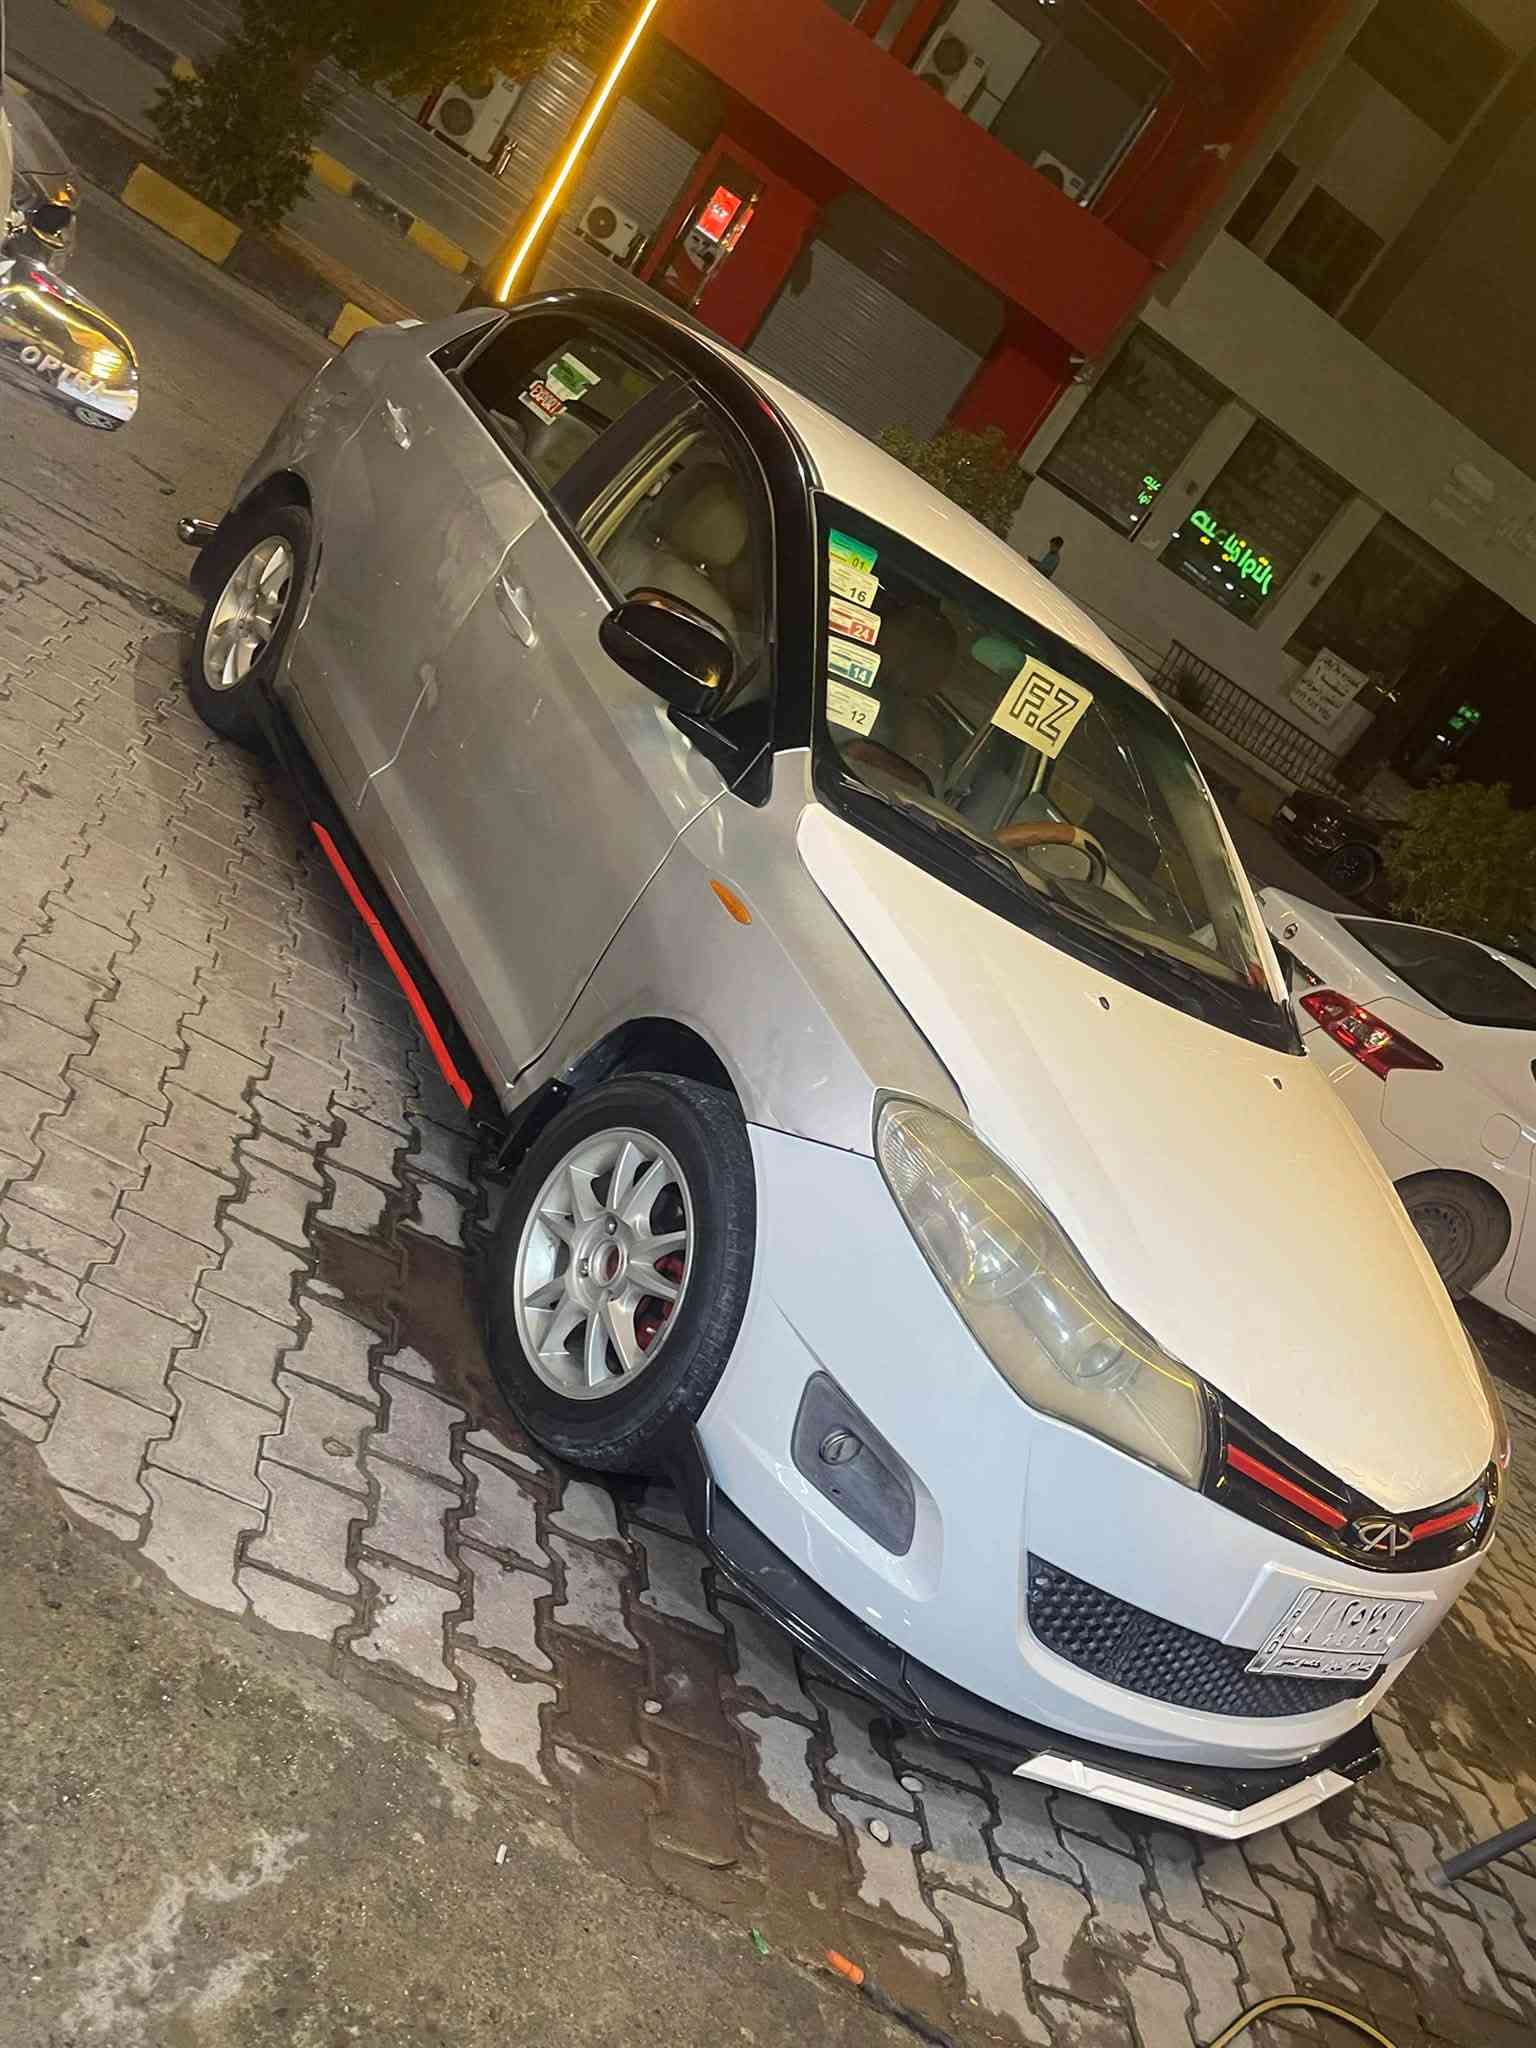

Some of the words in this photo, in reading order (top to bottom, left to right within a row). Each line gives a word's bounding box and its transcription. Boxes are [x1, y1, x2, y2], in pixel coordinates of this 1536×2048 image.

[852, 557, 866, 570] 01
[849, 587, 867, 602] 16
[853, 625, 870, 641] 24
[852, 667, 866, 682] 14
[850, 710, 867, 725] 12
